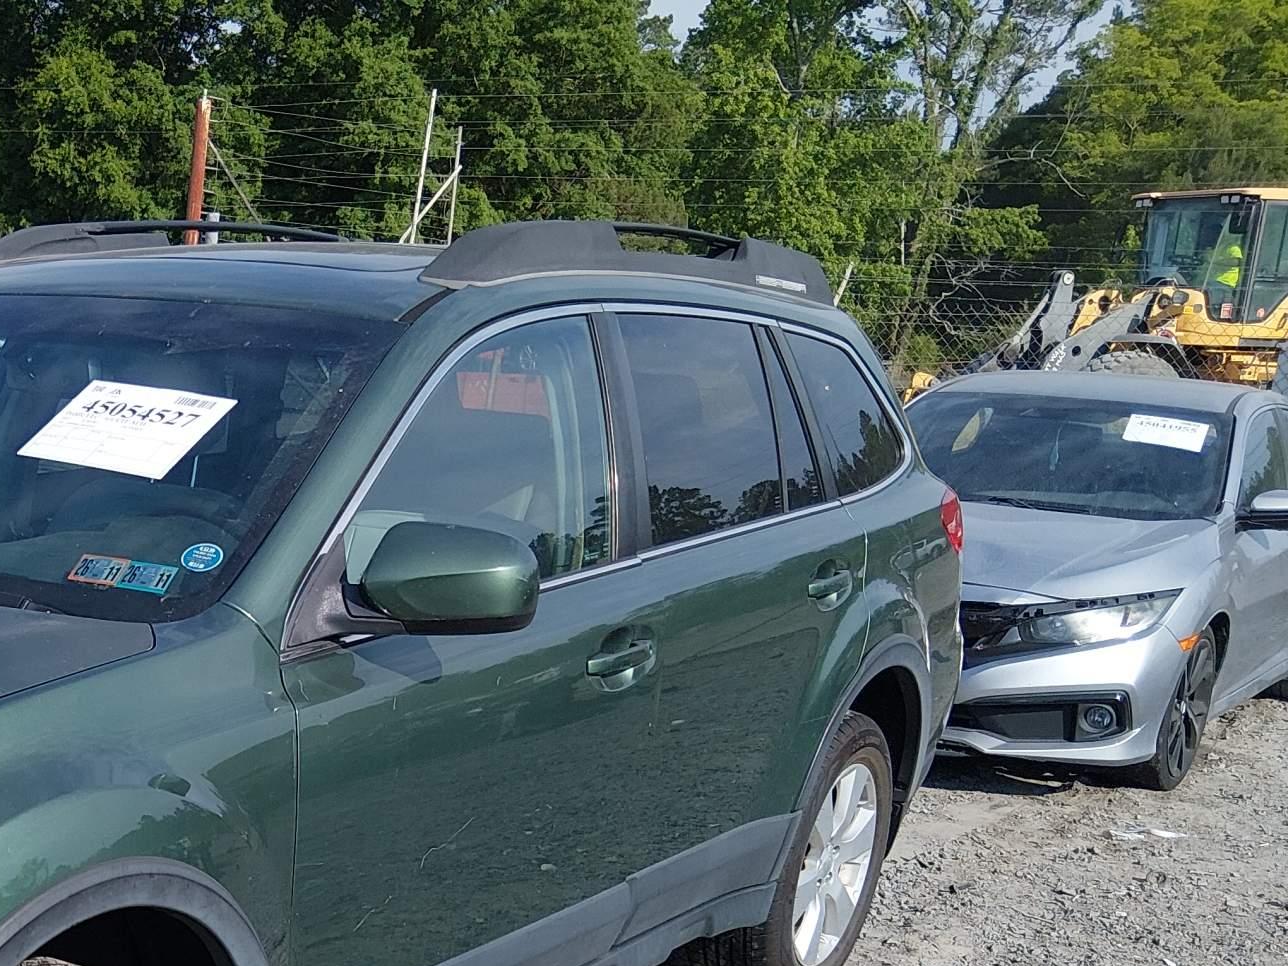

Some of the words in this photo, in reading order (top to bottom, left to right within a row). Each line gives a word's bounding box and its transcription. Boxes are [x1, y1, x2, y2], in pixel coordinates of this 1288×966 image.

[82, 399, 201, 429] 45054527
[74, 558, 94, 577] 26
[103, 566, 122, 582] 11
[121, 565, 142, 584] 26
[154, 572, 172, 589] 11
